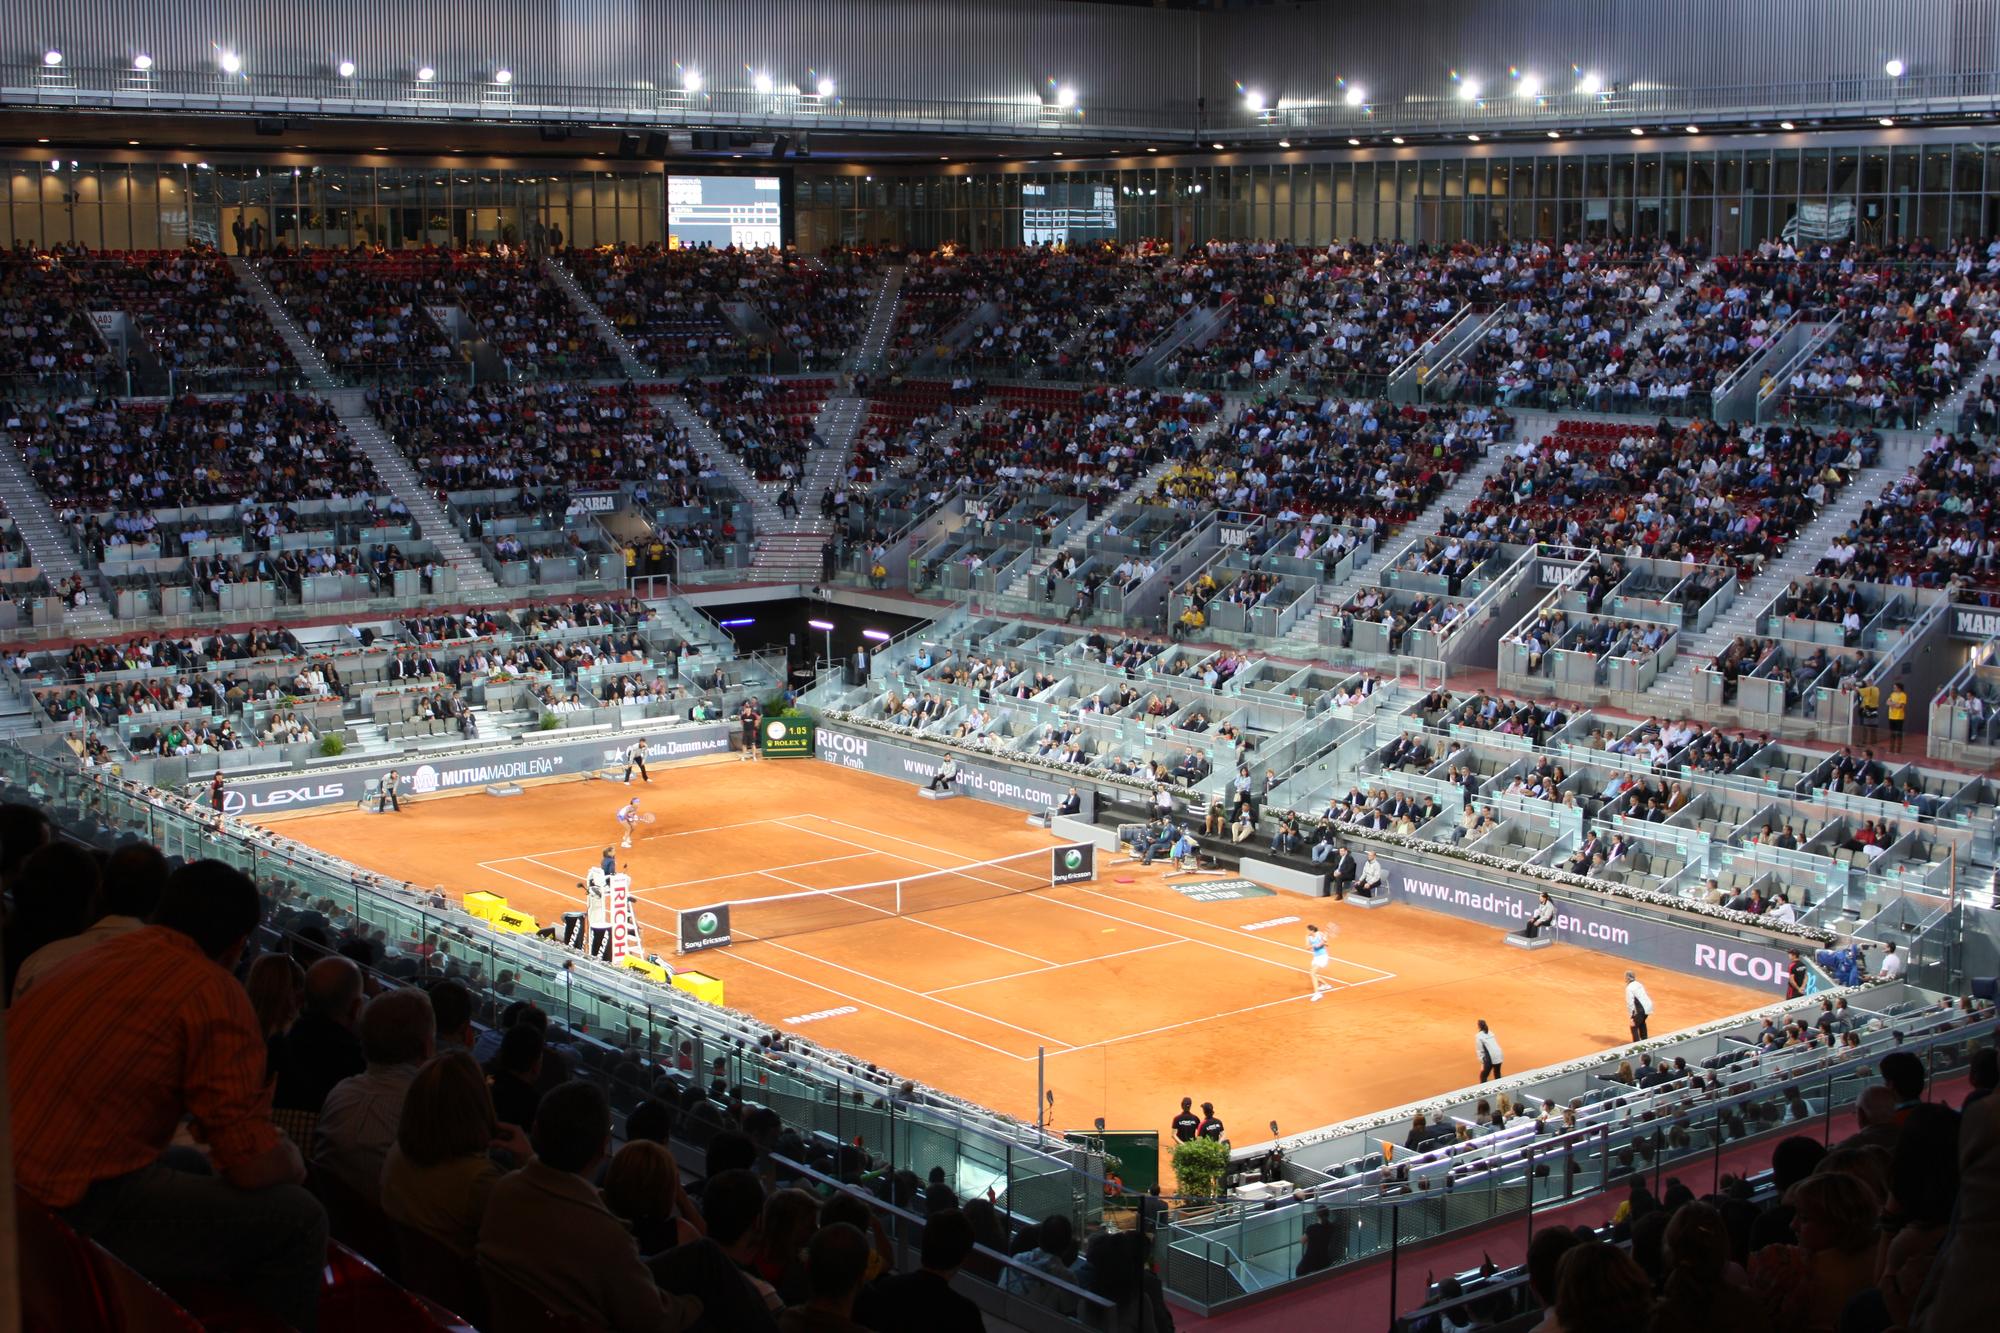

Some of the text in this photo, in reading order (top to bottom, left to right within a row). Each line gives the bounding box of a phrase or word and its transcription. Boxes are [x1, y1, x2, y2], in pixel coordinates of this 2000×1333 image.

[667, 740, 702, 755] Damm
[816, 730, 868, 757] RICOH
[442, 756, 553, 787] MUTUAMADRILEÑA
[824, 750, 865, 769] 157 Km/h
[251, 783, 345, 807] LEXUS
[903, 758, 1052, 806] www.drid-open.com
[614, 887, 626, 957] RICOH
[1402, 875, 1630, 946] www.madrid-en.com
[684, 935, 731, 949] Sony Ericsson
[1694, 943, 1790, 985] RICOH
[782, 1006, 858, 1024] MADRID
